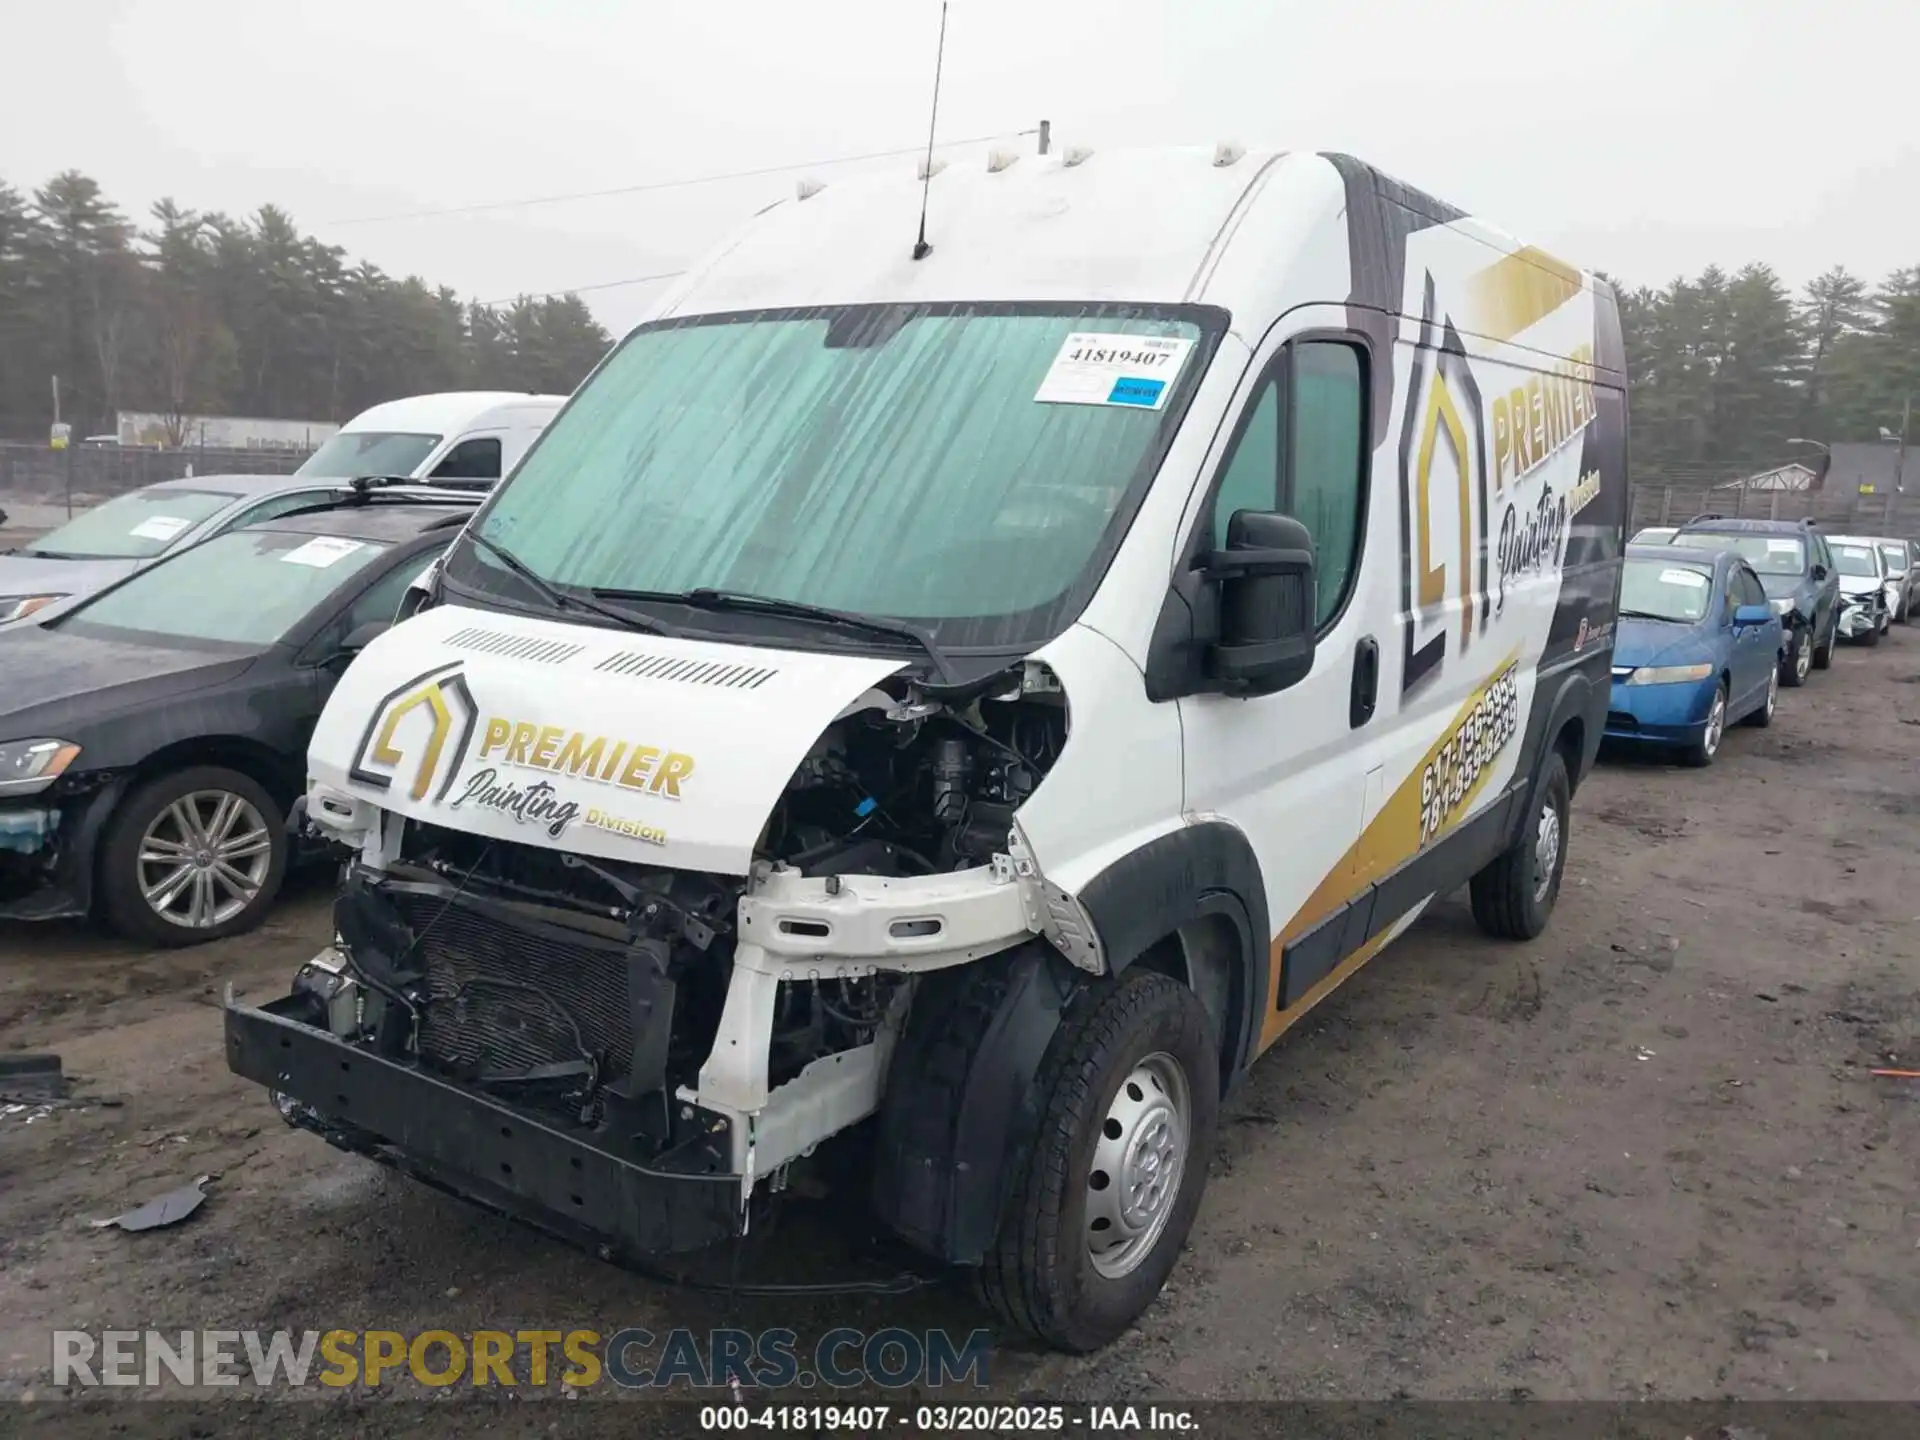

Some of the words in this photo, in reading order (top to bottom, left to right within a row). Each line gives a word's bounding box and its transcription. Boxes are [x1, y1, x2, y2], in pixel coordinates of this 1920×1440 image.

[1069, 347, 1171, 366] 41819407
[1491, 344, 1598, 497] PREMIER
[1496, 480, 1566, 612] Painting
[452, 767, 581, 838] Painting
[585, 808, 668, 845] Division
[478, 717, 696, 799] PREMIER
[1420, 699, 1516, 844] 781-859-8239
